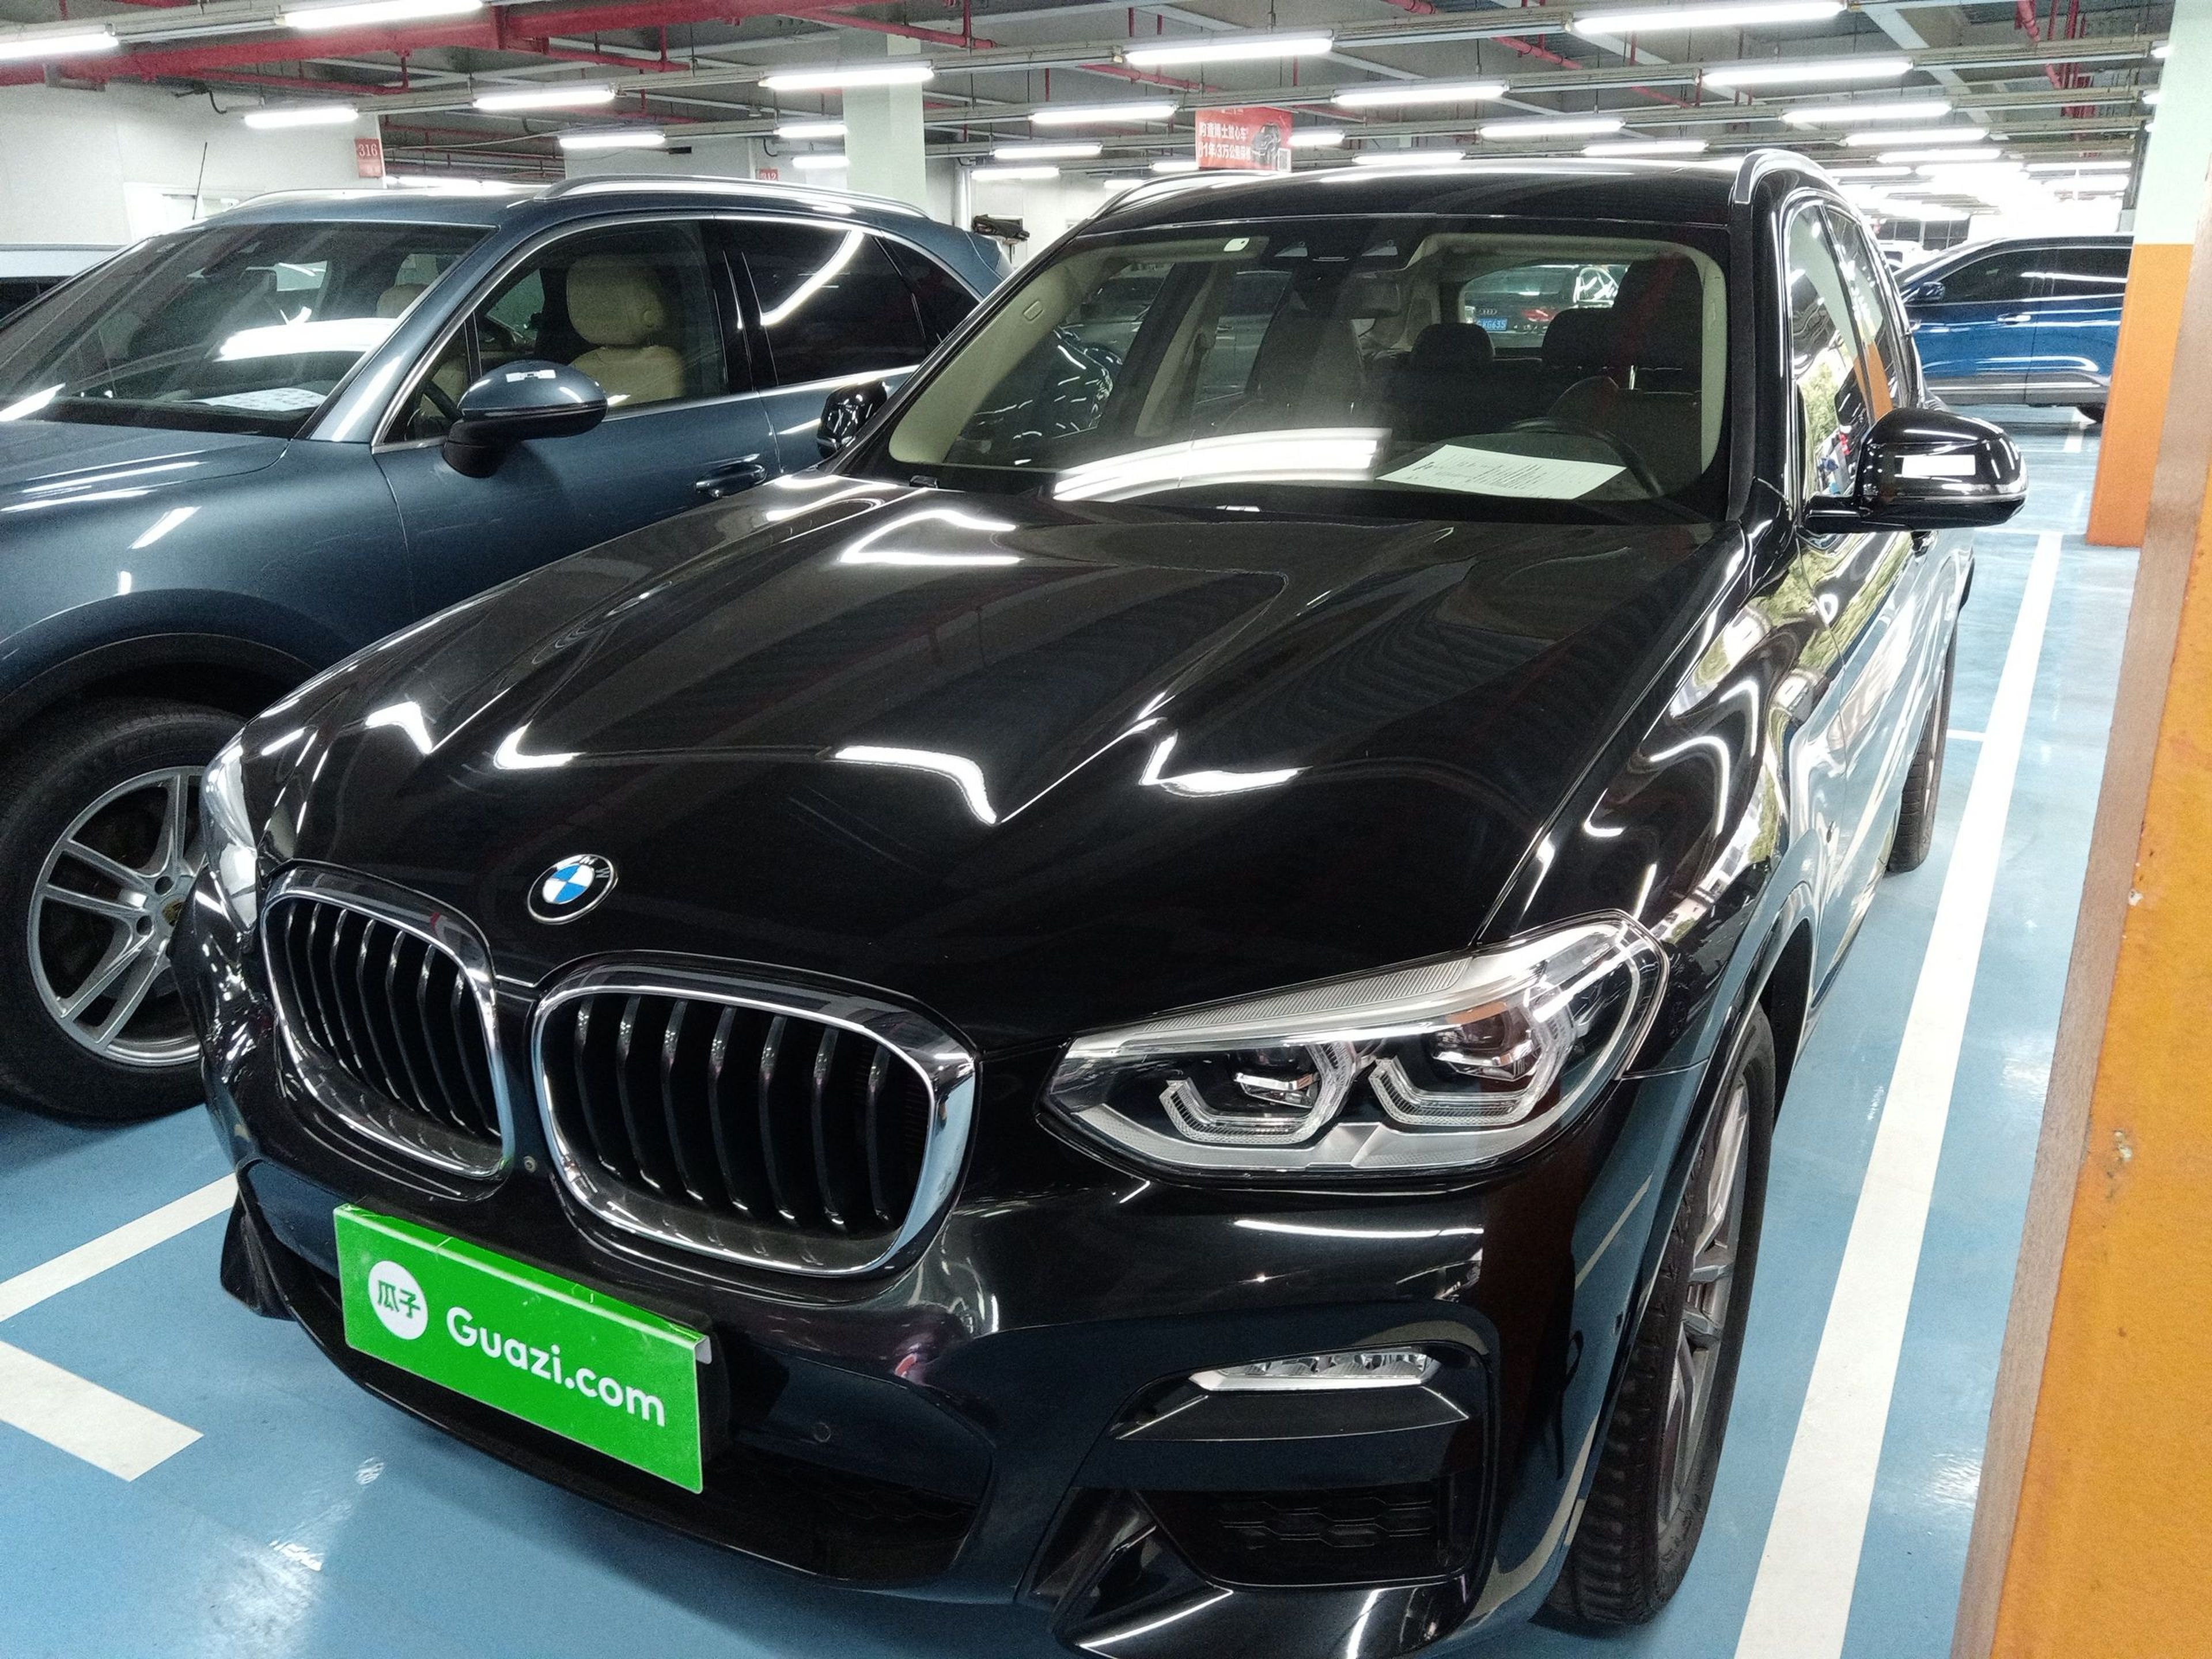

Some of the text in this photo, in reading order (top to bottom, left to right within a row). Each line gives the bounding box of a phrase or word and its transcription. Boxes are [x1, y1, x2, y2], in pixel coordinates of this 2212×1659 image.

[358, 143, 378, 157] 316
[378, 1280, 421, 1319] 瓜子
[446, 1306, 665, 1427] Guazi.com
